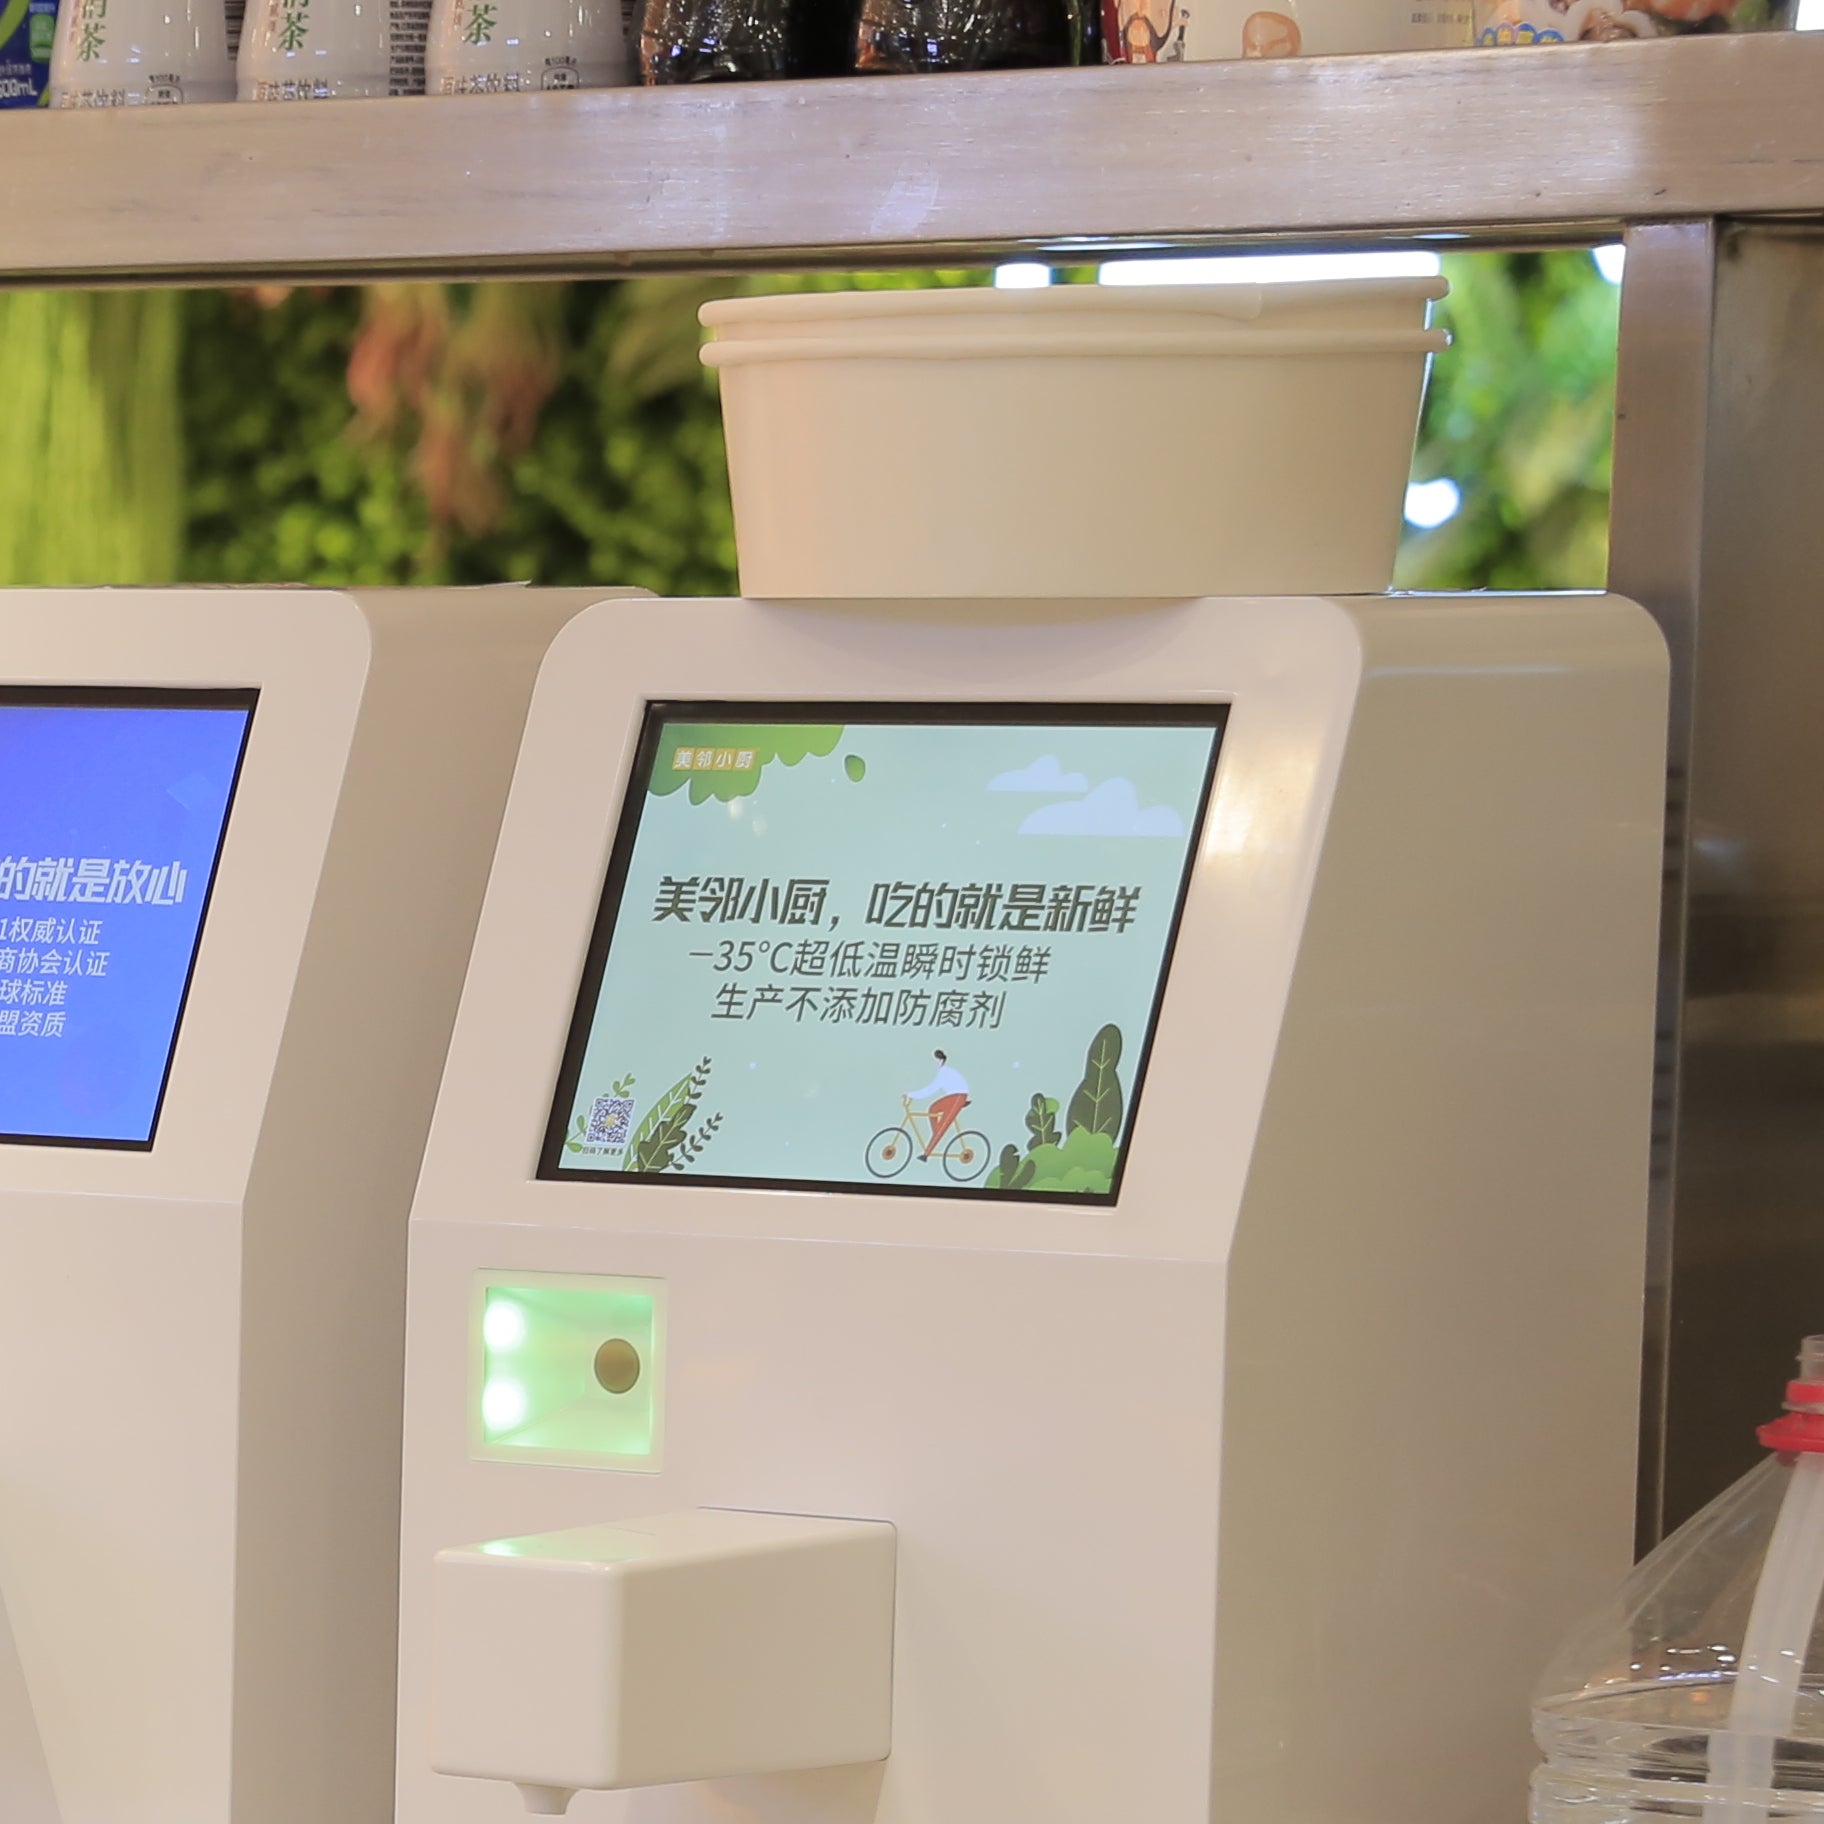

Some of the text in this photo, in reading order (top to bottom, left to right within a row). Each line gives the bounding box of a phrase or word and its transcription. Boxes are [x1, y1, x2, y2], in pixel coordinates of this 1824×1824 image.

[672, 748, 755, 770] 美邻小厨
[652, 875, 1143, 934] 美邻小厨，吃的就是新鲜
[710, 984, 1008, 1030] 生产不添加防腐剂
